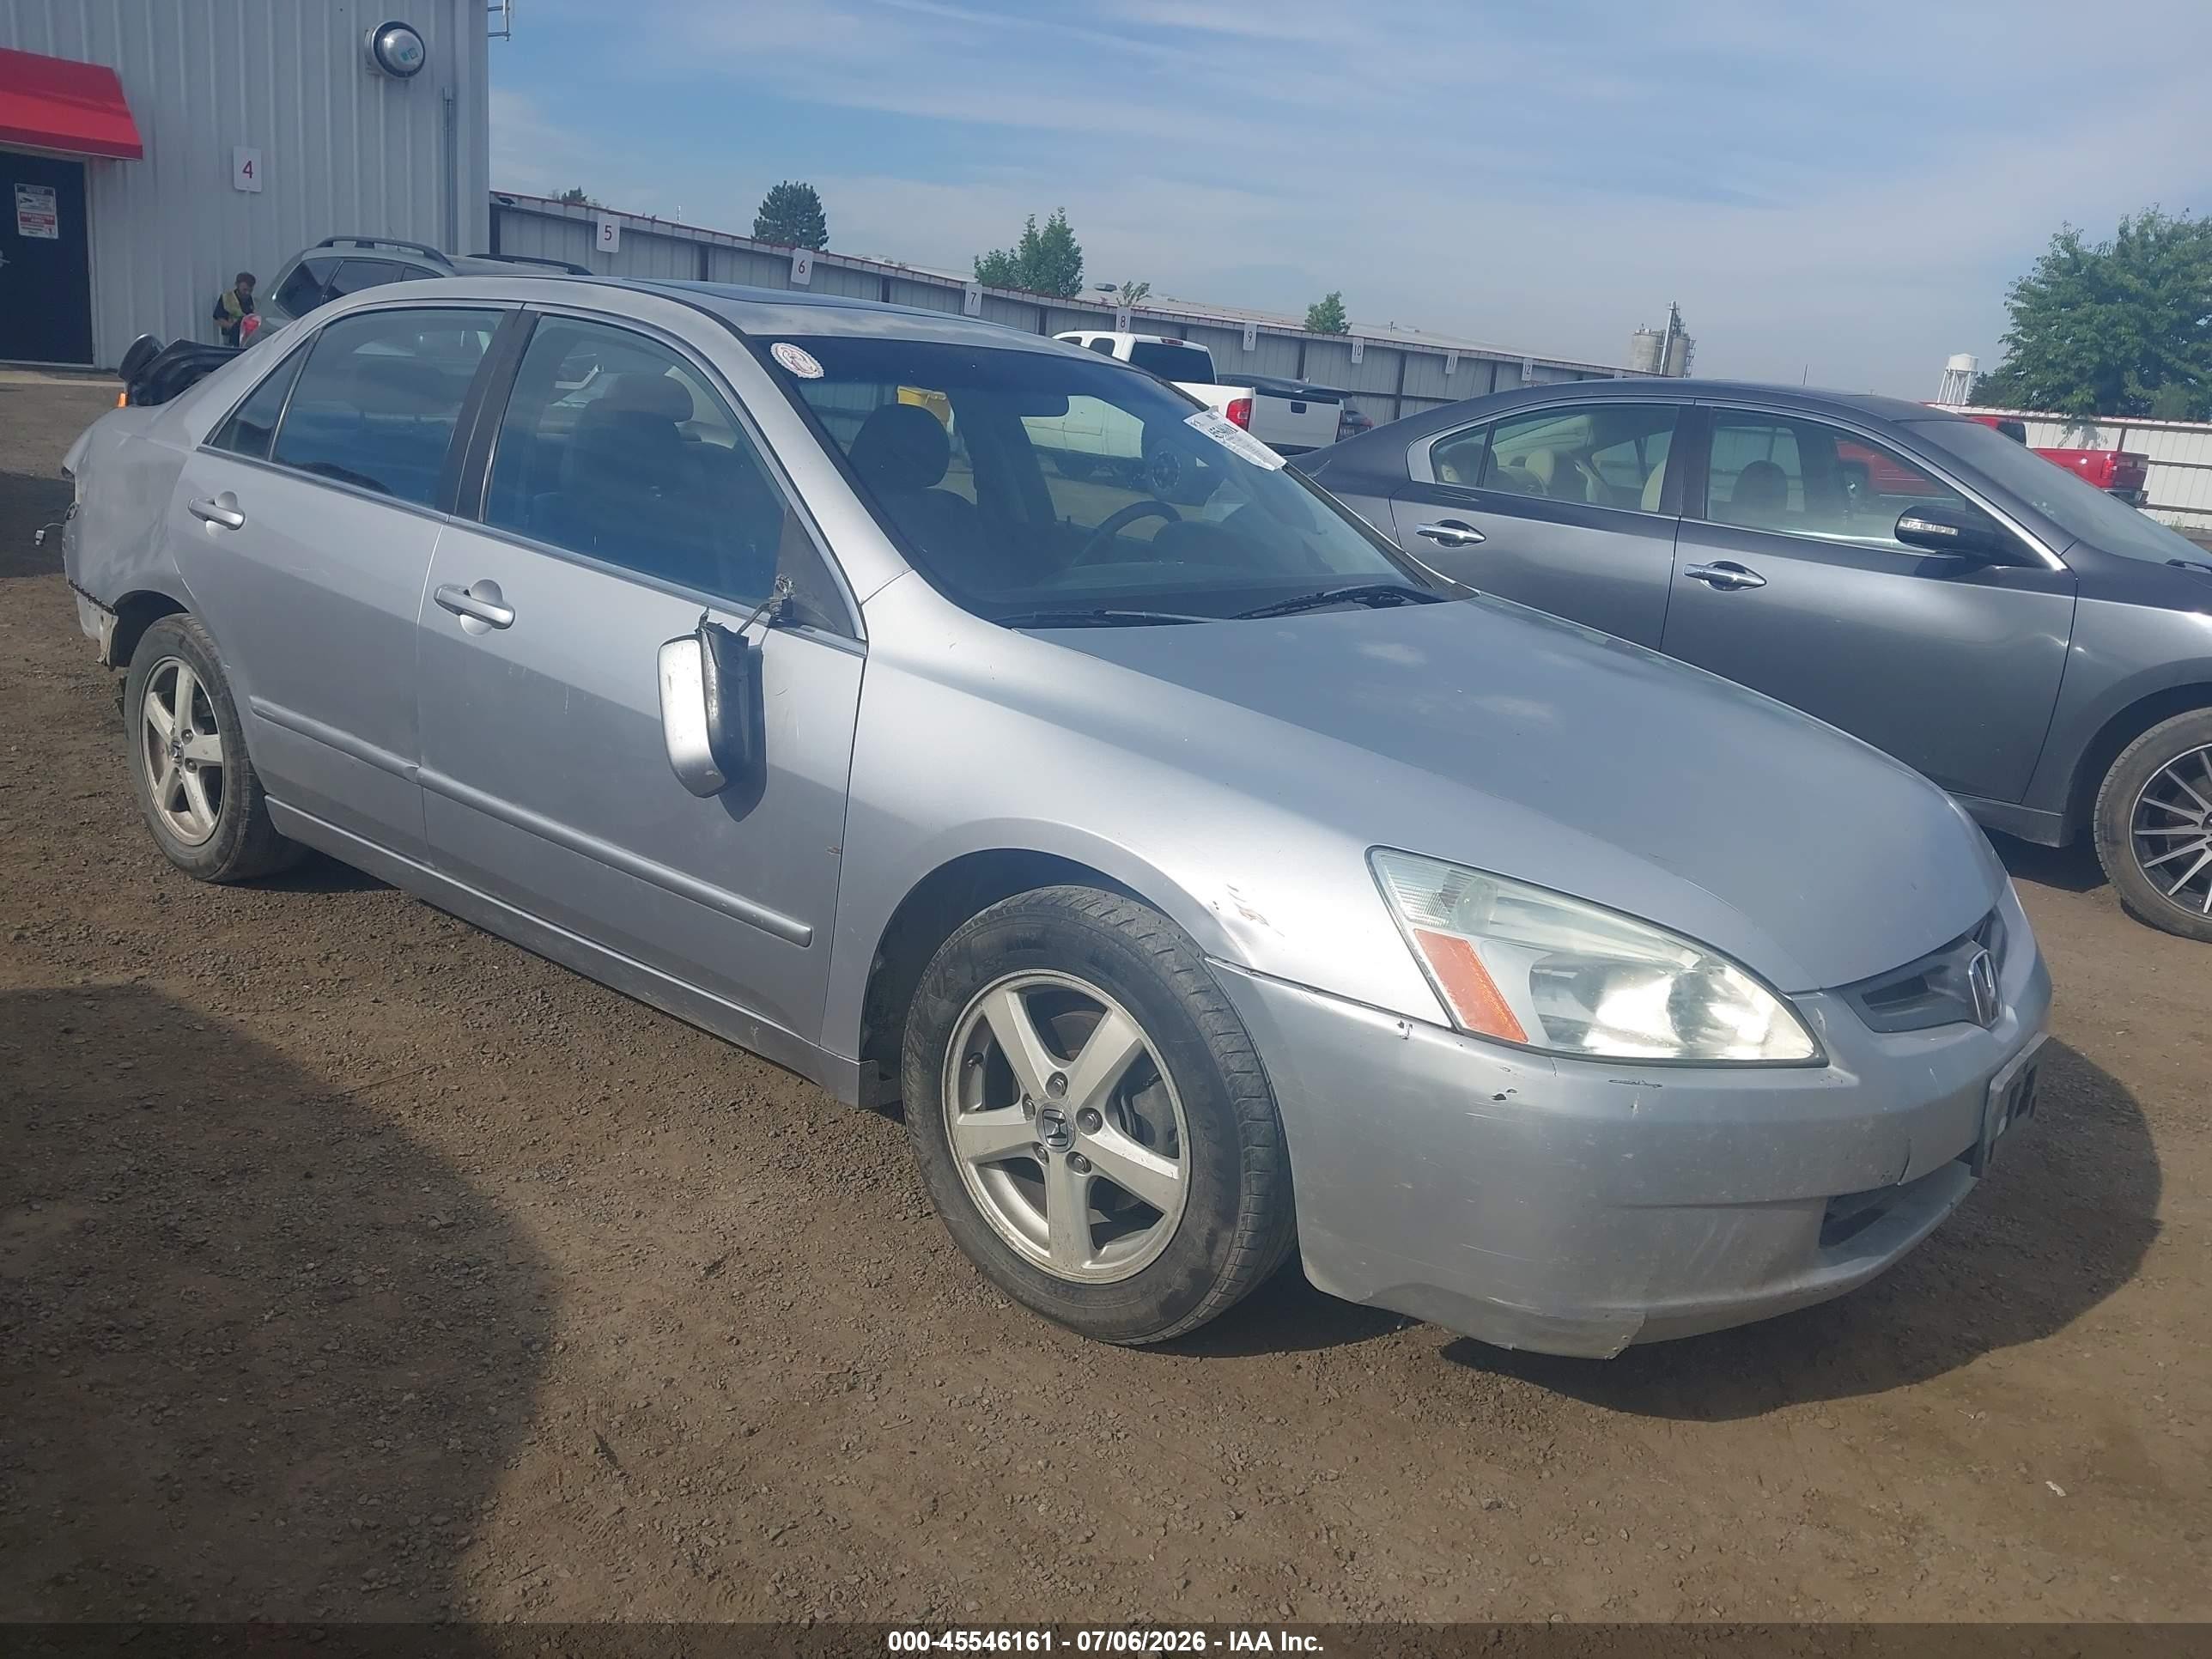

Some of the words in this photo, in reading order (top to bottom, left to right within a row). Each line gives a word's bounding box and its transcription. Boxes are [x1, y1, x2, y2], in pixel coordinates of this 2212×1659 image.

[242, 160, 254, 179] 4
[604, 224, 612, 240] 5
[798, 259, 805, 274] 6
[970, 291, 977, 306] 7
[1120, 315, 1126, 328] 8
[1248, 331, 1253, 343] 9
[1353, 343, 1362, 356] 10
[1449, 356, 1455, 367] 11
[1524, 364, 1531, 374] 12
